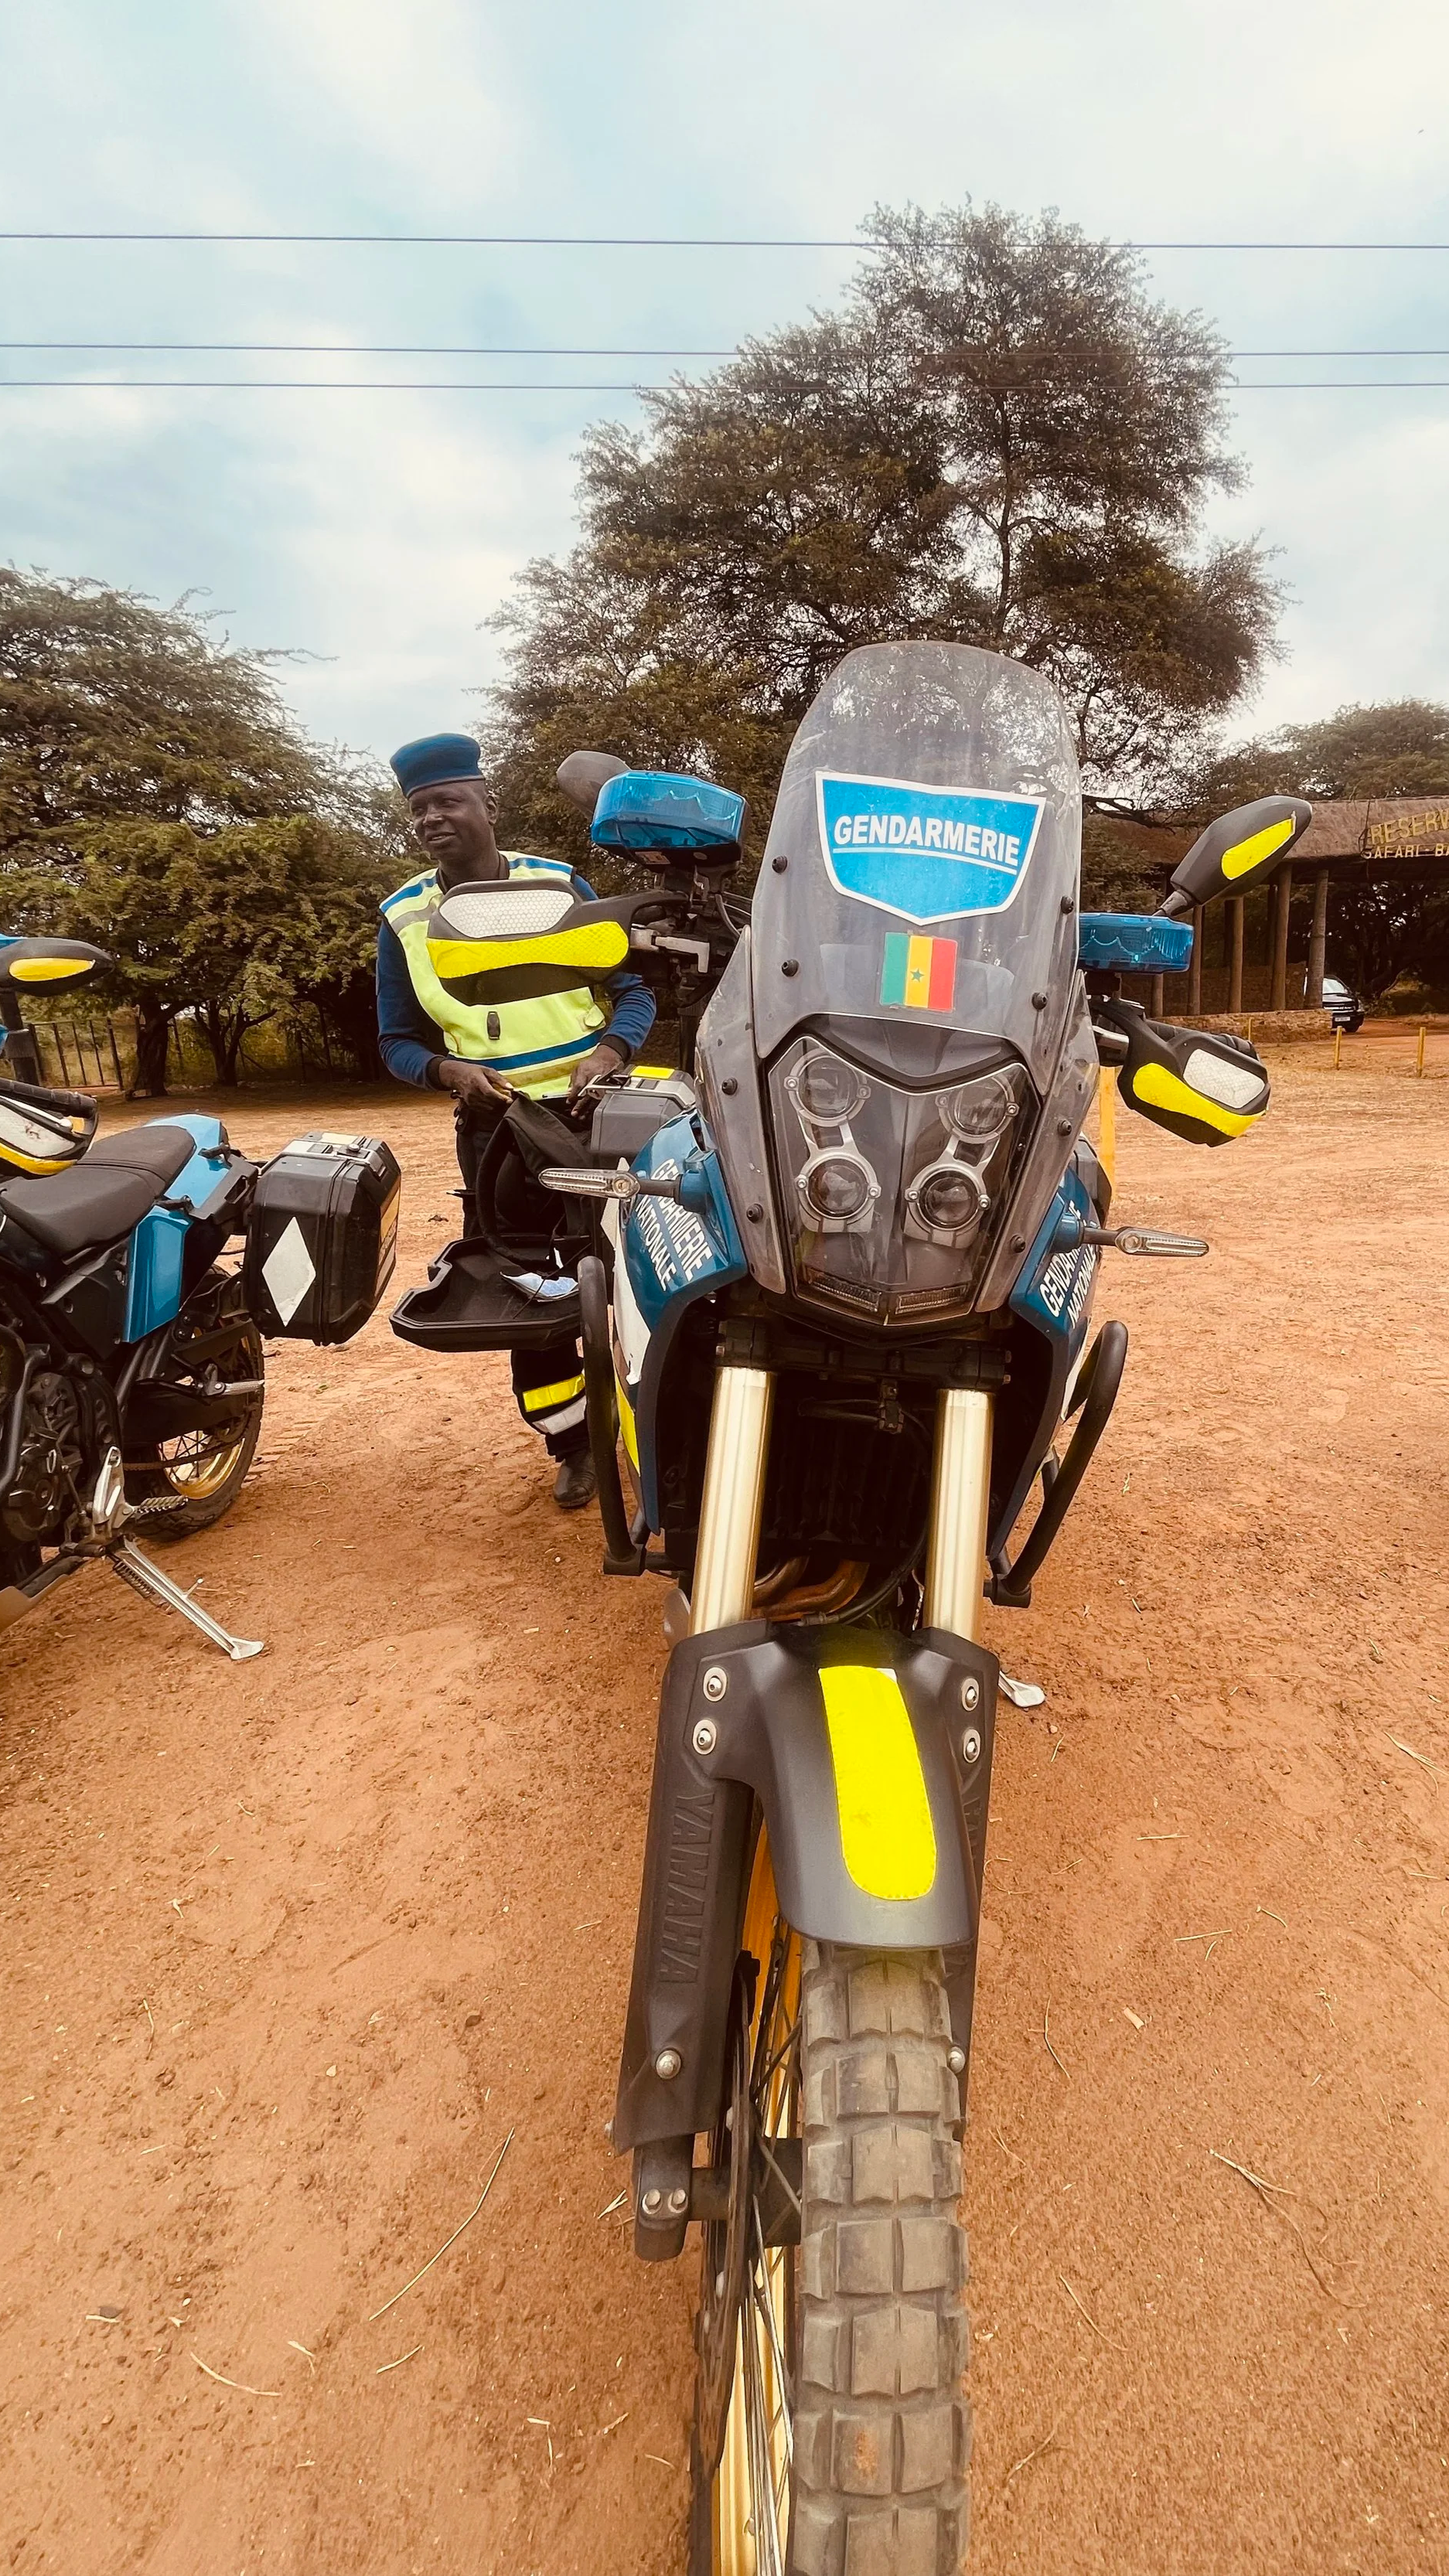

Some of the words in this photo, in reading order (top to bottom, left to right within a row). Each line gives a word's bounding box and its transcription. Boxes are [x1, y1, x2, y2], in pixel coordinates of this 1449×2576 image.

[834, 815, 1020, 867] GENDARMERIE
[635, 1194, 677, 1292] NATIONALE
[657, 1792, 715, 1984] YAMAHA
